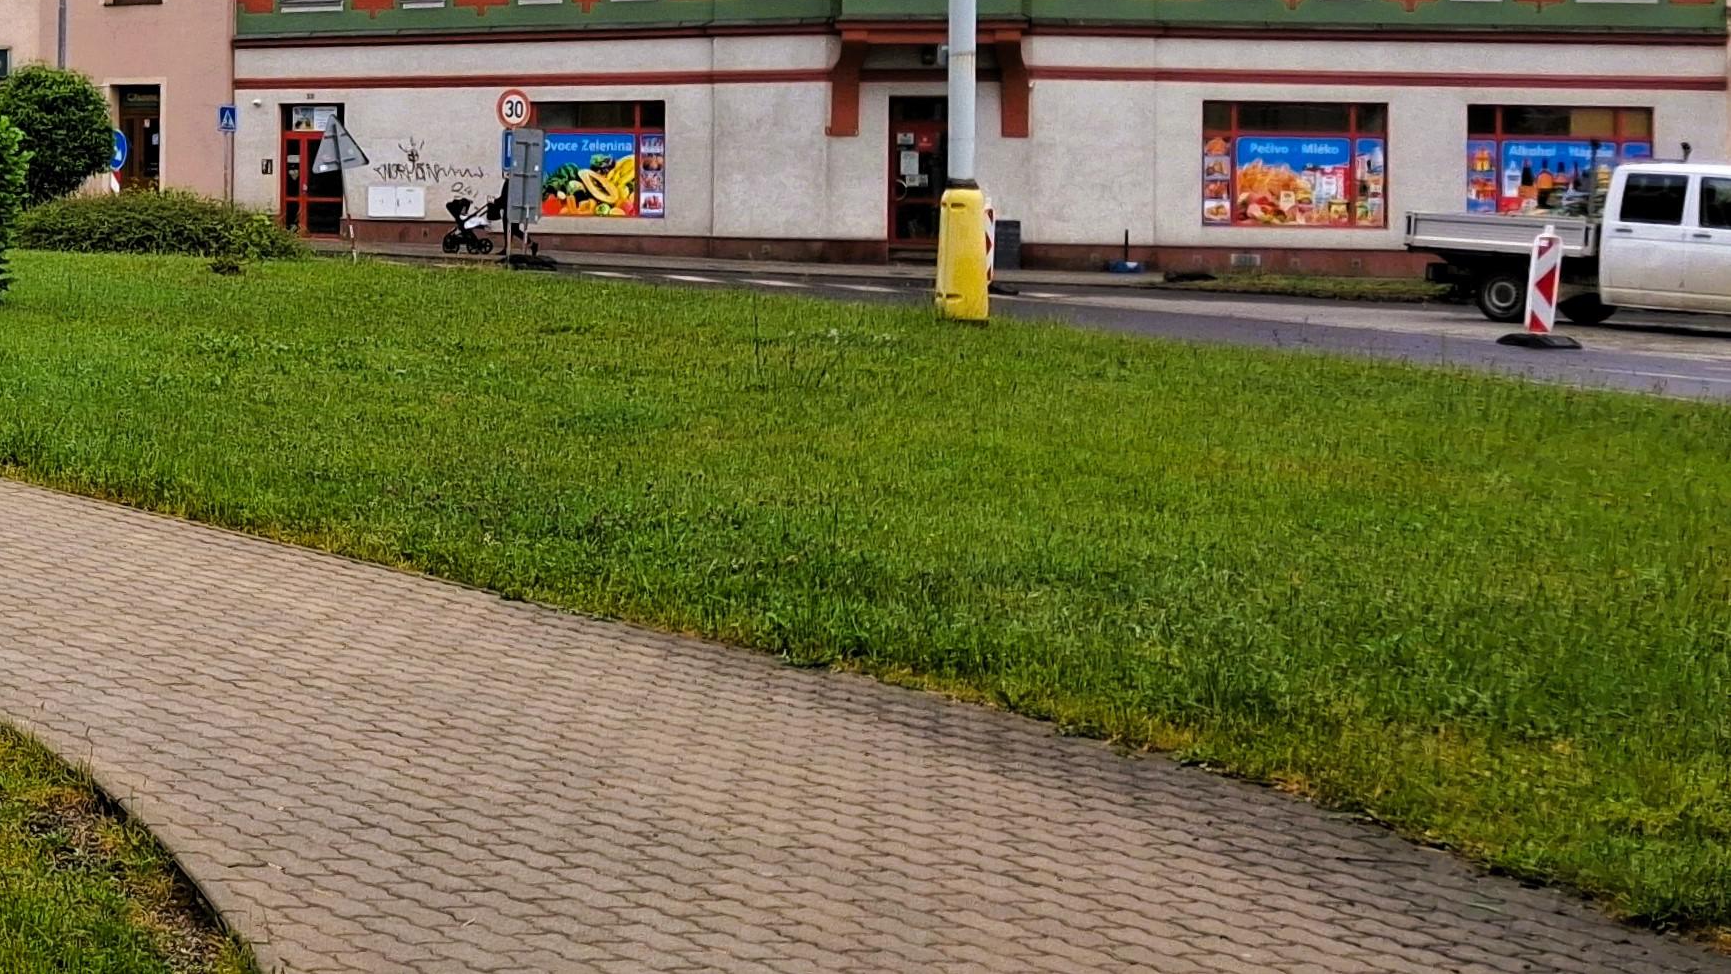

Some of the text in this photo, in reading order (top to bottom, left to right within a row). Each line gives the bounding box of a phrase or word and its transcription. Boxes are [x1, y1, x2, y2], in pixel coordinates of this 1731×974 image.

[504, 100, 524, 118] 30
[581, 139, 633, 152] Zelenina
[1250, 142, 1340, 155] Pečivo Mléko
